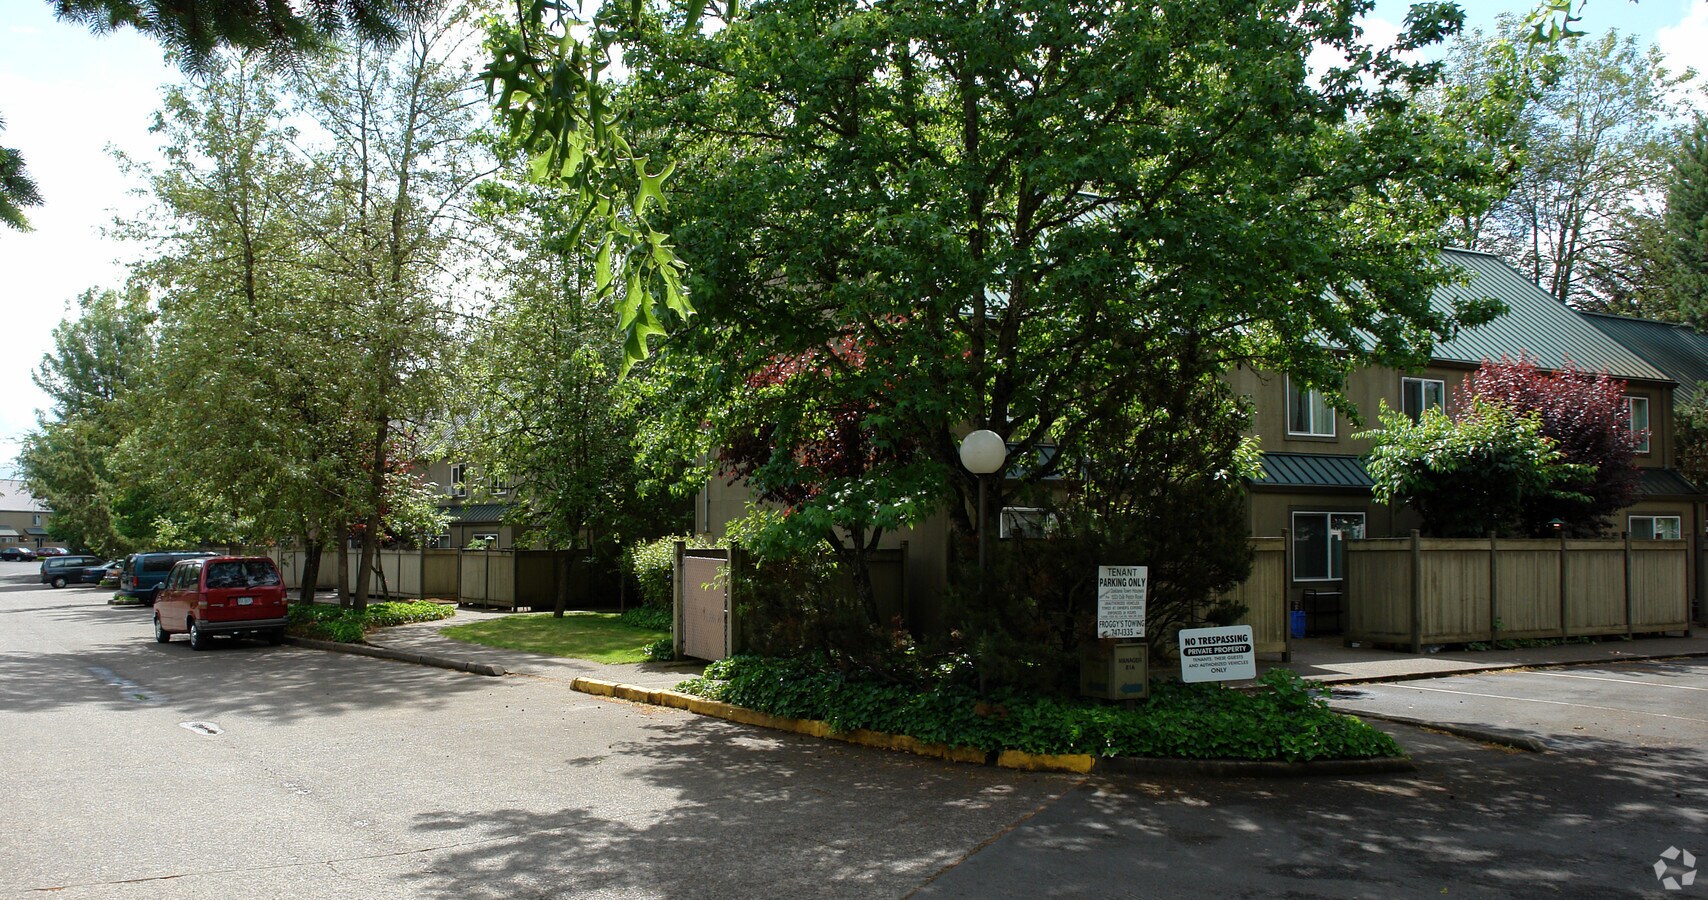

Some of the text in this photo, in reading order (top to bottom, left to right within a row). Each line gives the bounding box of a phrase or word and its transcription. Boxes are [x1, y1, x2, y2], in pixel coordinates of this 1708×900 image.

[1108, 568, 1137, 576] TENANT
[1100, 578, 1146, 587] PARKING ONLY
[1185, 634, 1248, 646] NO TRESPASSING
[1188, 645, 1247, 655] PRIVATE PROPERTY
